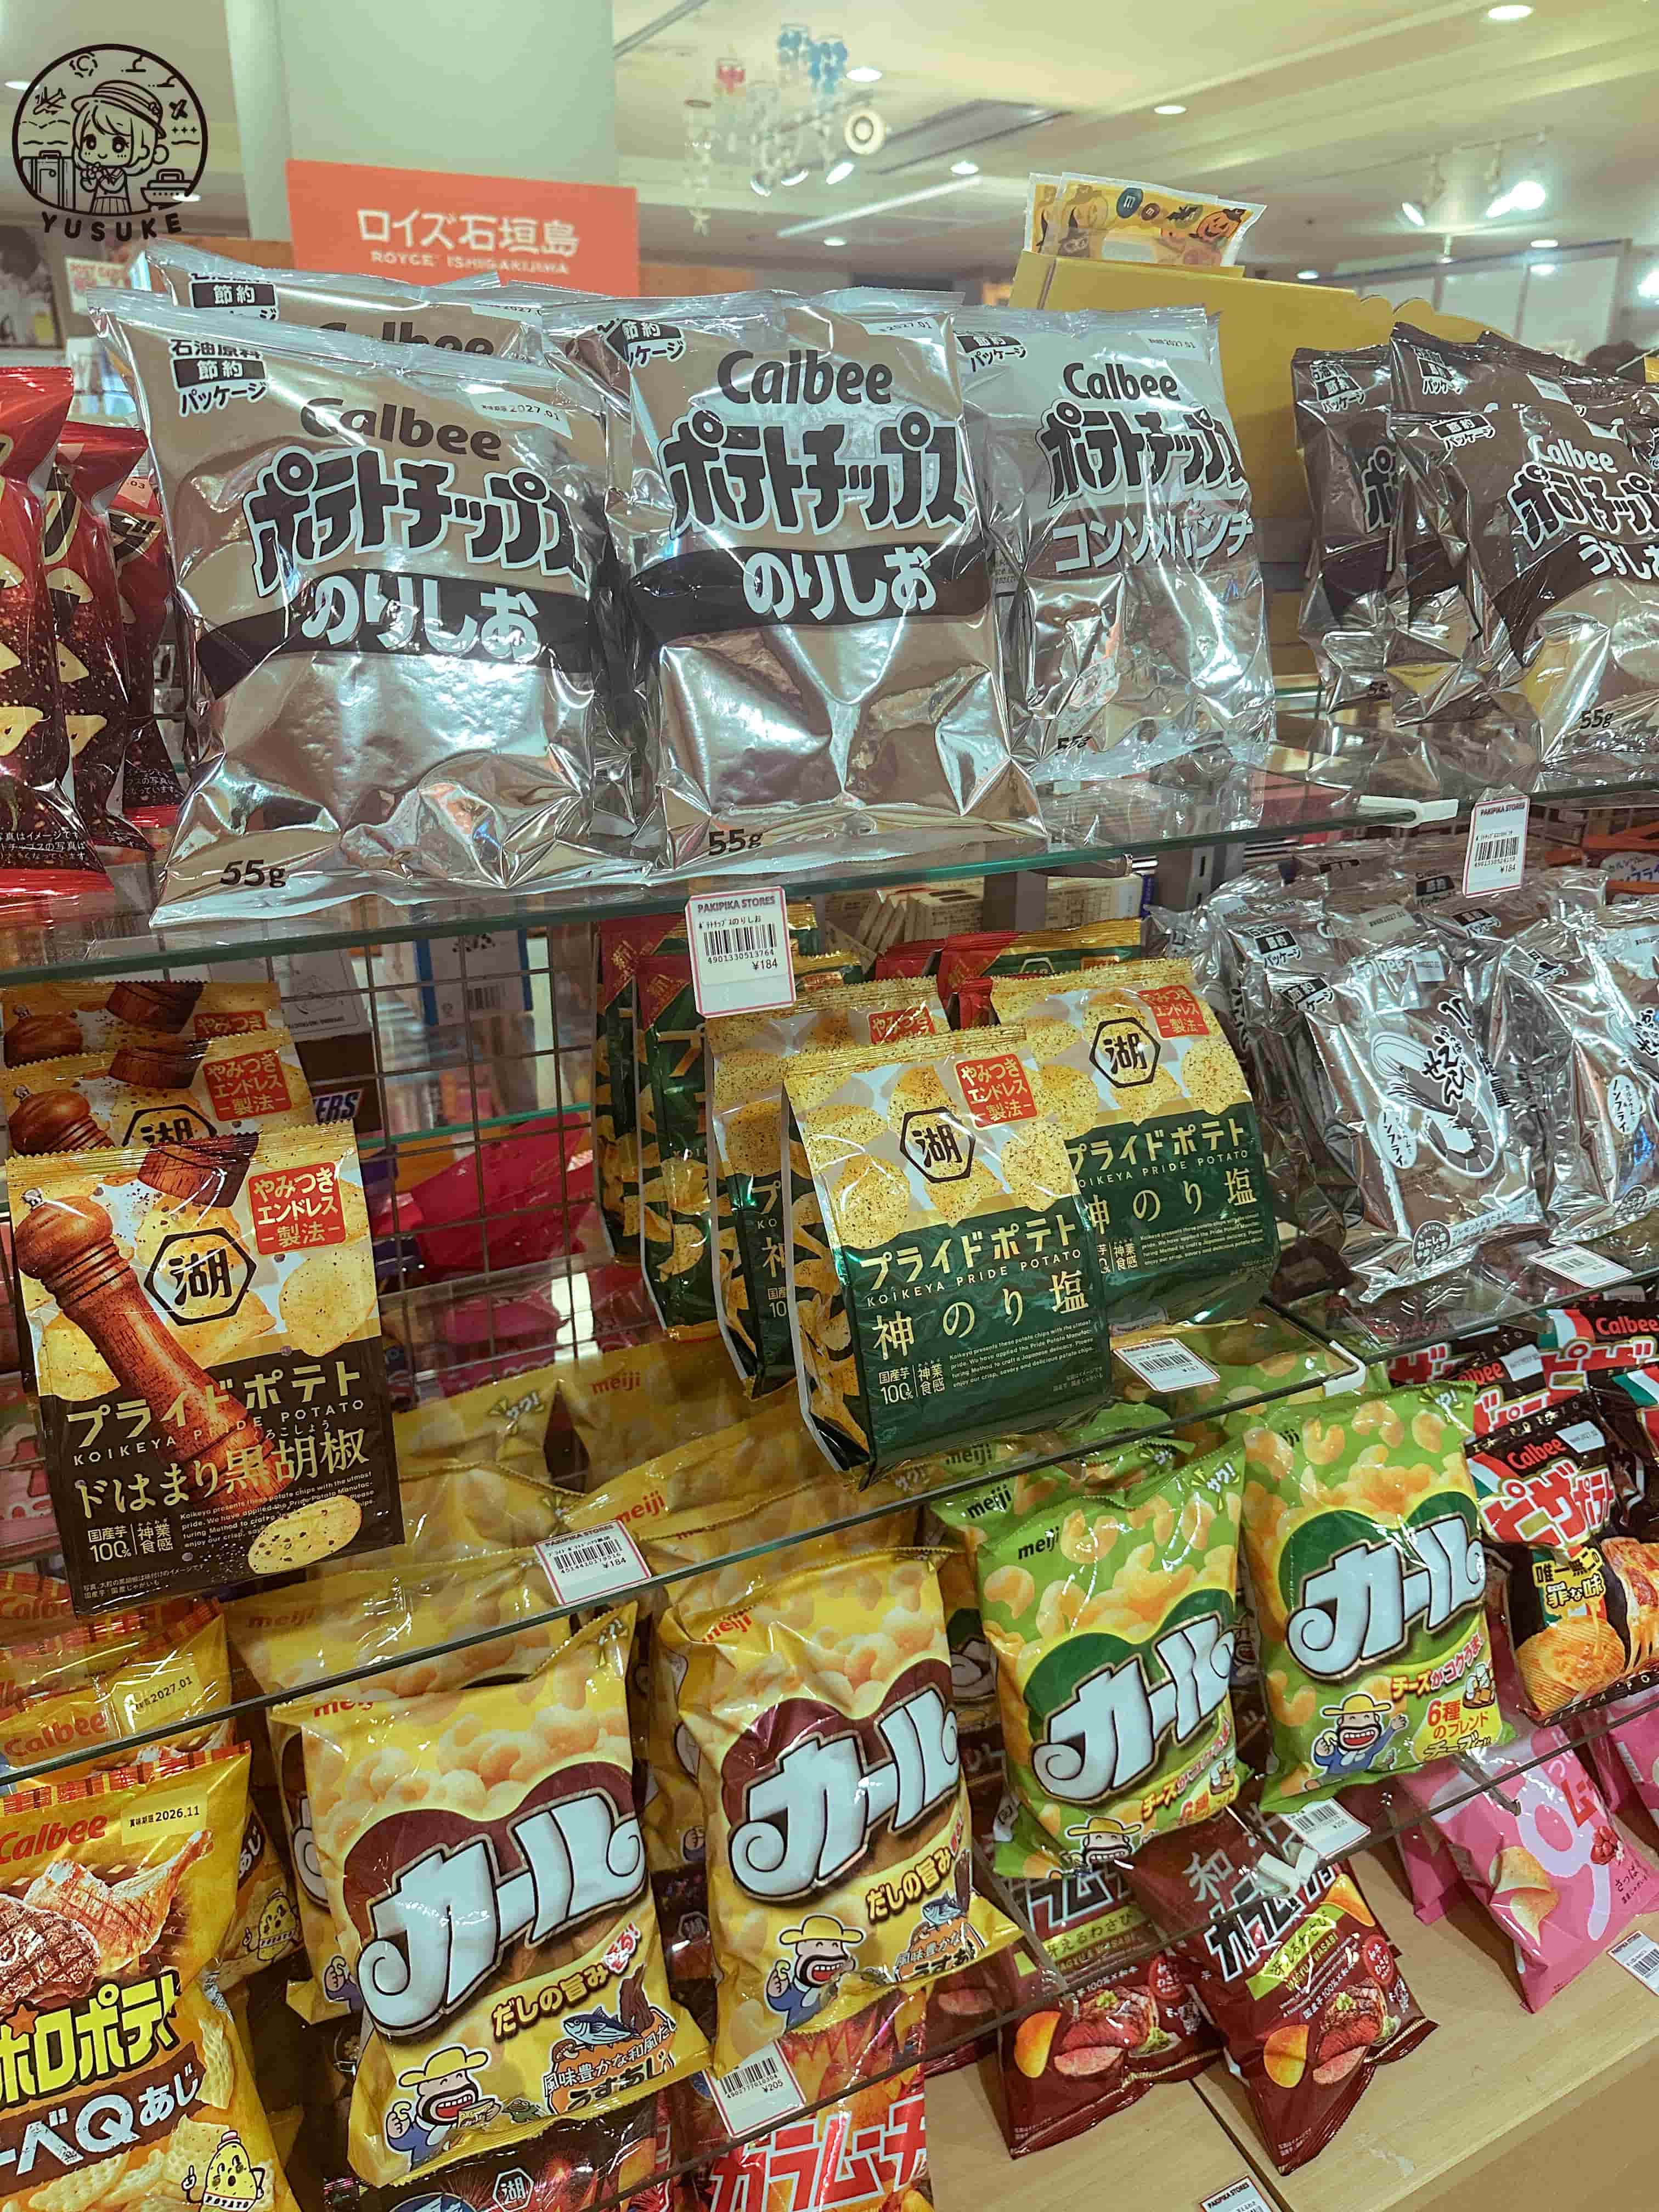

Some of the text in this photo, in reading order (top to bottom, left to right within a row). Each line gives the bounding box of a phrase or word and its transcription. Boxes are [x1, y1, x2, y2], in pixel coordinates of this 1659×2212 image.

[357, 208, 579, 257] ロイズ石垣島
[213, 284, 256, 305] 節約
[197, 359, 242, 380] 節約
[970, 347, 1026, 373] パッケージ
[717, 350, 893, 404] Calbee
[1063, 362, 1181, 401] Calbee
[180, 381, 268, 415] パッケージ
[301, 398, 501, 461] Calbee
[1039, 402, 1250, 509] ポテトチップス
[1527, 435, 1618, 473] Calbee
[661, 410, 968, 540] ポテトチップス
[246, 449, 589, 596] ポテトチップス
[743, 547, 937, 621] のりしお
[301, 574, 543, 662] のりしお
[1580, 709, 1613, 730] 55g
[708, 829, 763, 856] 55g
[220, 860, 286, 888] 55g
[697, 895, 776, 913] PAKIPIKA STORES
[708, 949, 775, 964] 4901330513764
[752, 959, 778, 971] ¥184
[1263, 947, 1301, 968] パッケージ
[196, 1014, 267, 1033] やみつき
[1156, 1003, 1200, 1018] エンドレス
[1170, 1019, 1200, 1035] 製法
[206, 1052, 280, 1080] やみつき
[1103, 1034, 1147, 1075] 湖
[213, 1076, 284, 1098] エンドレス
[961, 1058, 1021, 1086] やみつき
[233, 1093, 274, 1115] 製法
[968, 1080, 1028, 1103] エンドレス
[989, 1099, 1024, 1123] 製法
[912, 1124, 962, 1168] 湖
[1067, 1118, 1245, 1176] プライドポテト
[1079, 1149, 1249, 1189] OIKEYA PRIDE POTATO
[253, 1171, 336, 1203] やみつき
[257, 1197, 338, 1224] エンドレス
[278, 1223, 327, 1248] 製法
[860, 1215, 1076, 1291] プライドポテト
[168, 1249, 234, 1305] 湖
[867, 1249, 1082, 1308] KOIKEYA PRIDE POTATO
[872, 1269, 1089, 1361] 神のり塩
[1594, 1315, 1659, 1336] Calbee
[592, 1370, 642, 1397] meiji
[878, 1363, 943, 1385] 国産芋 神業
[920, 1376, 946, 1397] 食感
[1456, 1362, 1505, 1387] albee
[66, 1363, 362, 1448] プライドポテト
[881, 1383, 914, 1405] 100%
[73, 1399, 365, 1466] KOIKEYA PRIDE POTATO
[1507, 1438, 1567, 1470] Calbee
[76, 1429, 370, 1519] ドはまり黒胡椒
[295, 1486, 316, 1498] chips
[317, 1481, 334, 1493] with
[334, 1479, 346, 1488] the
[347, 1471, 373, 1486] utmost
[966, 1485, 1012, 1520] meiji
[1482, 1458, 1616, 1547] ピザポテト
[87, 1523, 171, 1543] 国産芋 神業
[140, 1537, 174, 1554] 食感
[1017, 1527, 1060, 1560] meiji
[89, 1540, 132, 1563] 100%
[601, 1558, 627, 1569] ¥184
[1286, 1515, 1487, 1678] カール
[1545, 1573, 1605, 1609] 罪な味
[1391, 1634, 1483, 1701] チーズがコクうま
[1032, 1615, 1236, 1803] カール
[1426, 1697, 1461, 1728] 6種
[4, 1708, 108, 1758] Calbee
[731, 1686, 958, 1898] カール
[0, 1815, 108, 1865] Calbee
[866, 1848, 952, 1920] だしの旨み
[358, 1793, 648, 2033] カール
[493, 1964, 609, 2039] だしの旨み
[543, 2017, 677, 2091] 風味豊かな和風だし
[762, 2079, 784, 2094] ¥205
[204, 2194, 251, 2209] POTATO
